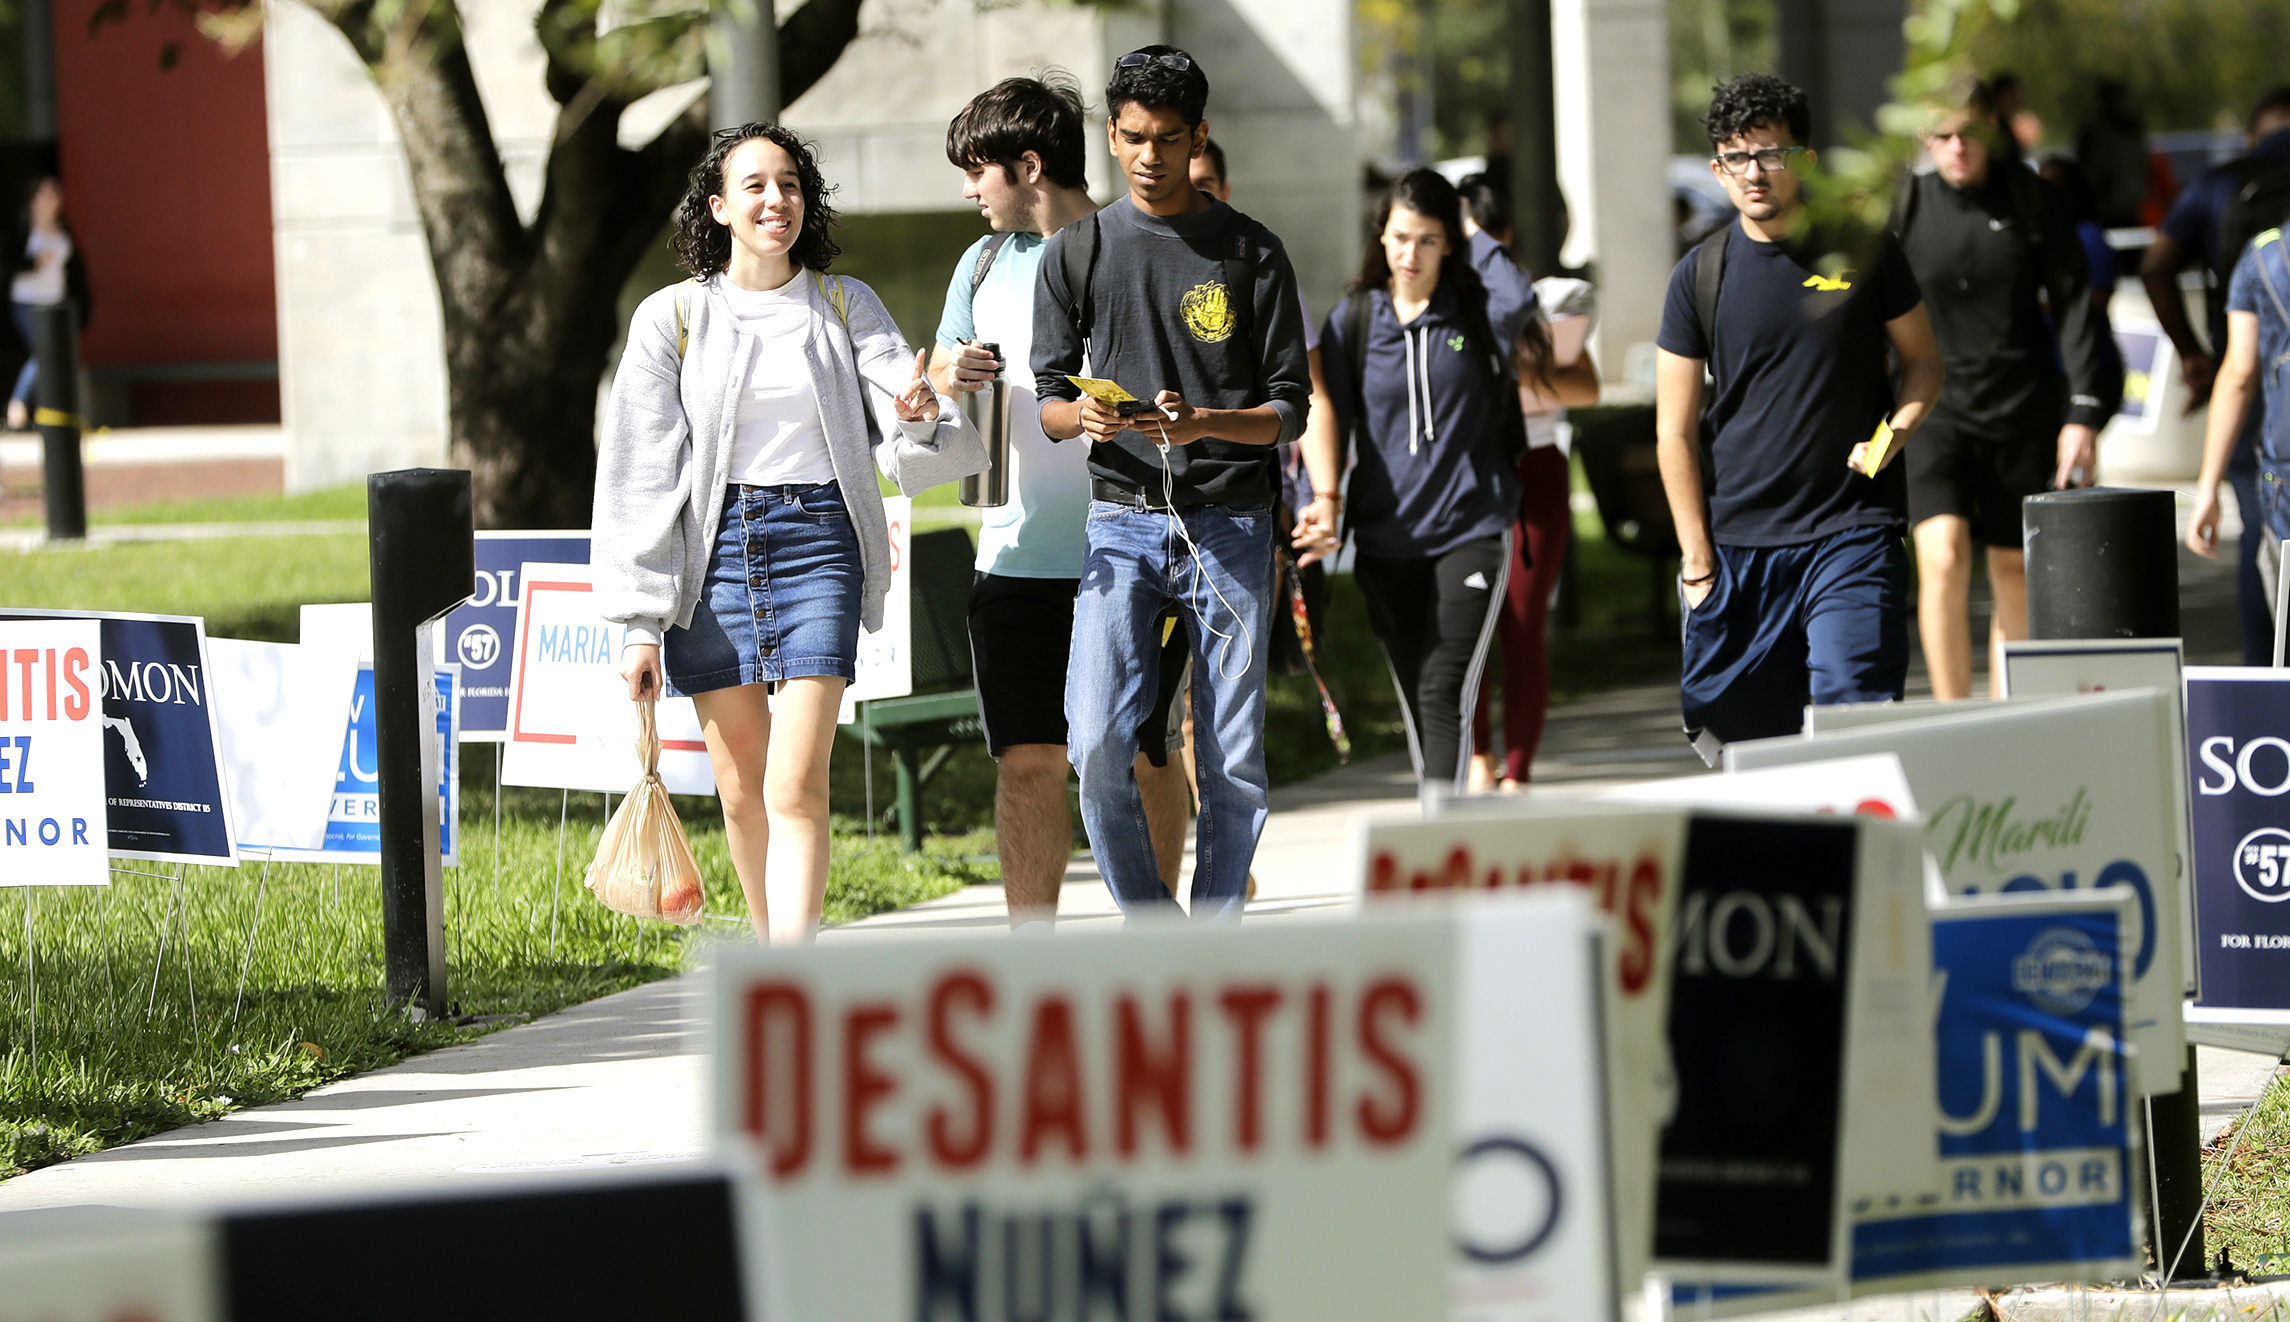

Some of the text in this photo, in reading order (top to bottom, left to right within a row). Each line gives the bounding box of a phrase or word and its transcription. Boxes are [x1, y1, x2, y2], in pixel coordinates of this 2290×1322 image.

[538, 624, 611, 665] MARIA
[2199, 736, 2290, 797] SO
[107, 797, 118, 806] OF
[118, 798, 173, 810] REPRESENTATIVES
[172, 802, 202, 813] DISTRICT
[5, 817, 90, 846] NOR
